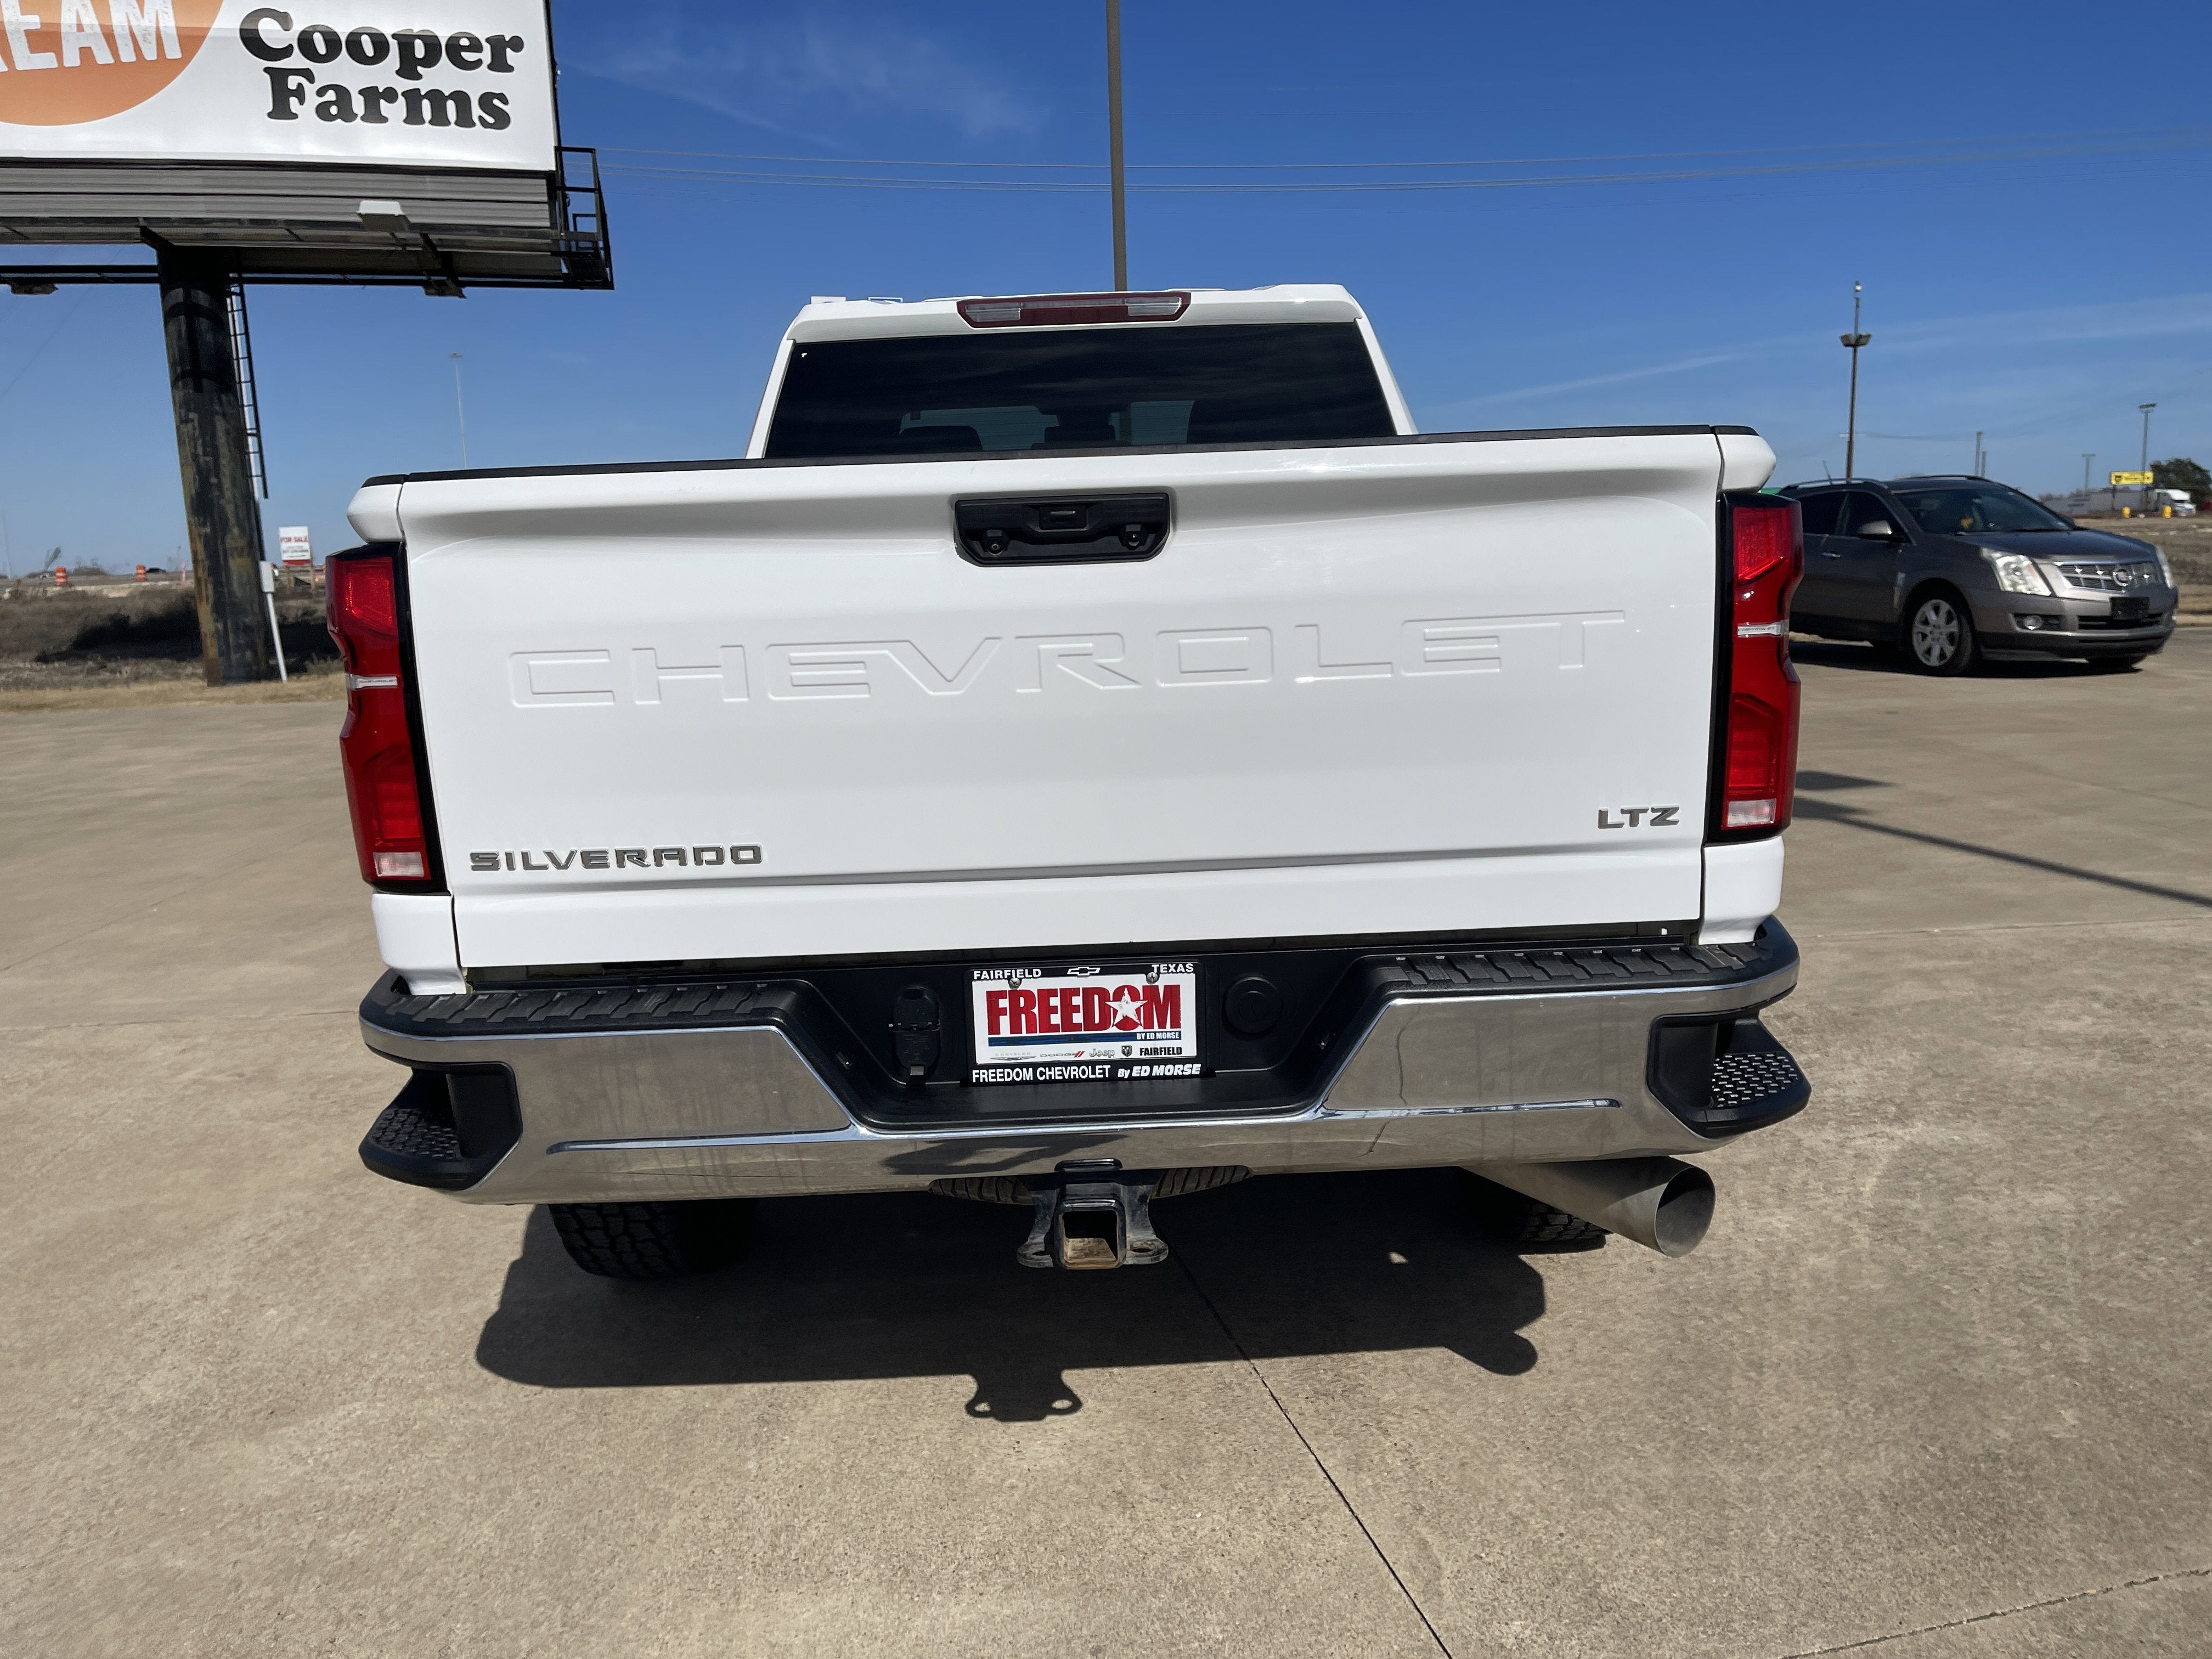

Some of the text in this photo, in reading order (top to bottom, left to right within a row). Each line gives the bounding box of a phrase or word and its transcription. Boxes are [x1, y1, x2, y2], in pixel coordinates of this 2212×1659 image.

[0, 0, 182, 72] EAM
[239, 8, 524, 81] Cooper
[263, 67, 511, 131] Farms
[510, 610, 1626, 707] CHEVROLET
[1598, 804, 1680, 830] LTZ
[469, 843, 764, 871] SILVERADO
[973, 968, 1042, 980] FAIRFIELD
[1152, 963, 1194, 974] TEXAS
[986, 985, 1181, 1034] FREEDOM
[1089, 1048, 1115, 1058] Jeep
[1139, 1046, 1182, 1056] FAIRFIELD
[972, 1067, 1033, 1083] FREEDOM
[1036, 1065, 1111, 1080] CHEVROLET
[1132, 1066, 1150, 1077] ED
[1152, 1064, 1201, 1076] MORSE
